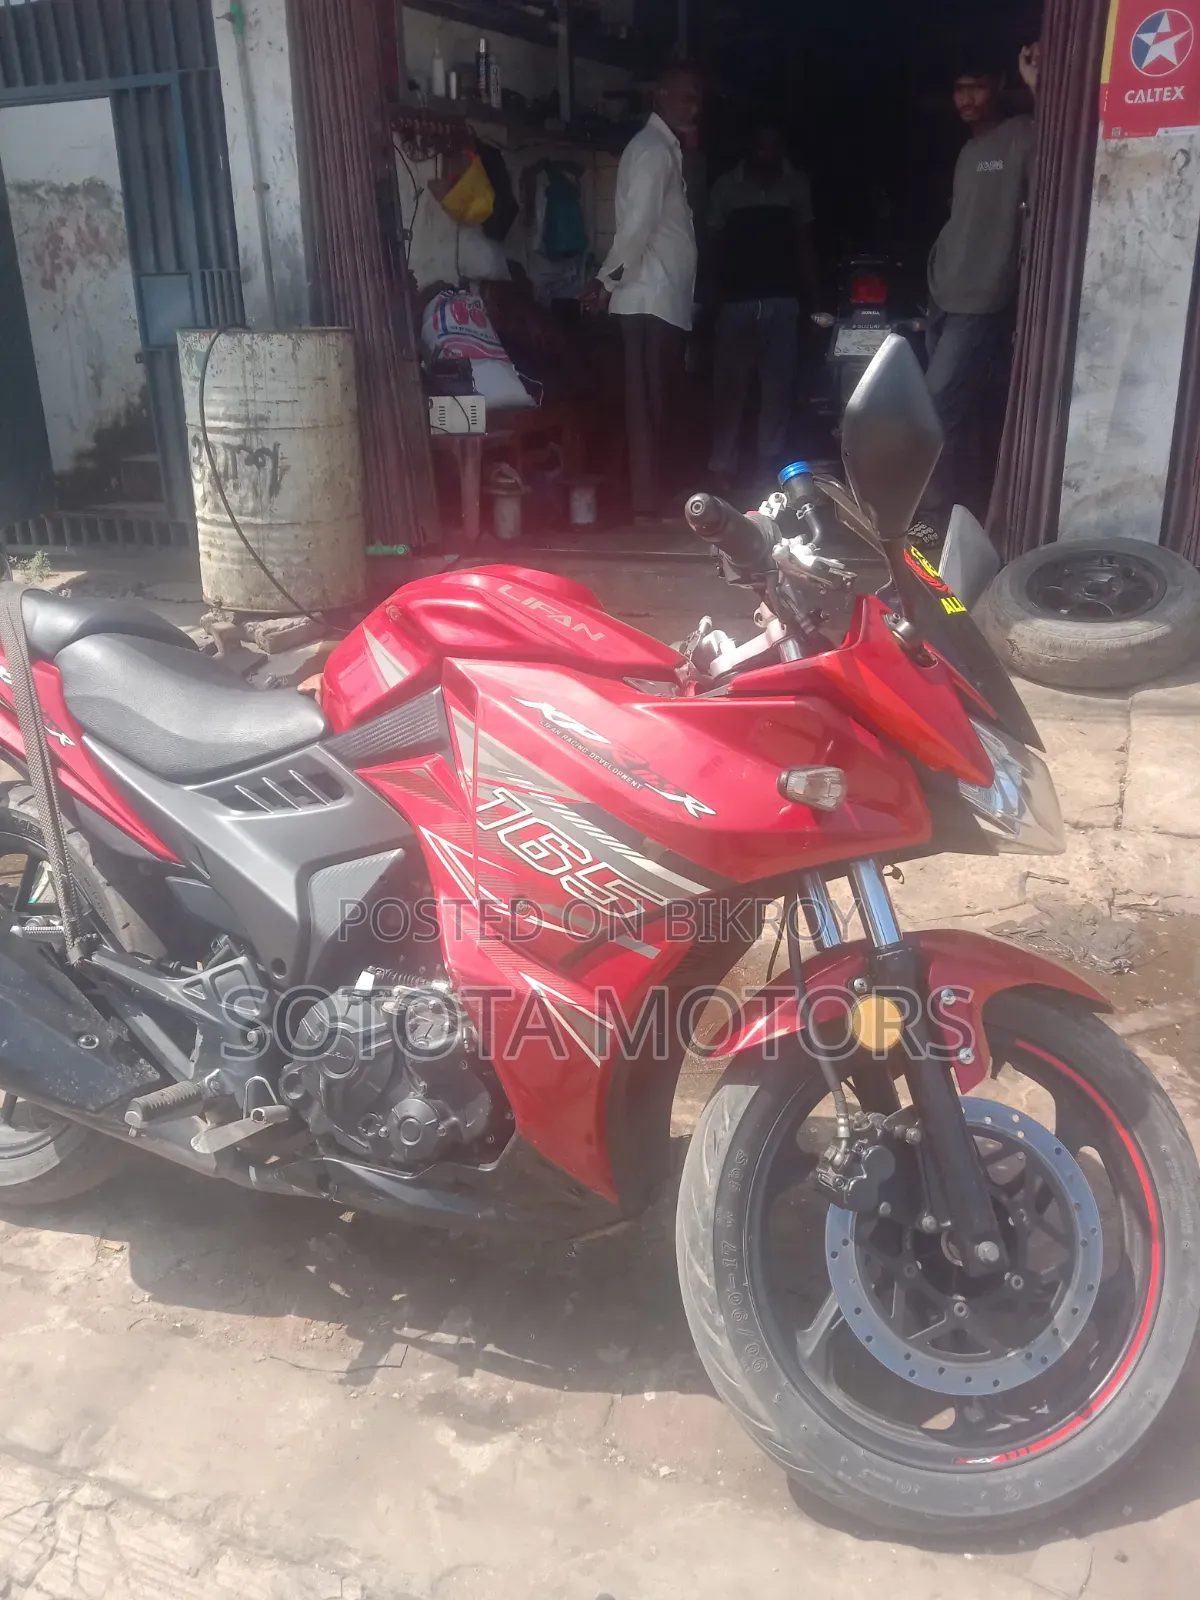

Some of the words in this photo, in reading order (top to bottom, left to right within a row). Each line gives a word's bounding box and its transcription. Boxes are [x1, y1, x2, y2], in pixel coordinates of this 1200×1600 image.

[1124, 85, 1185, 104] CALTEX
[496, 584, 606, 642] LIFAN
[539, 719, 561, 735] LIFAN
[561, 733, 589, 754] RACING
[589, 751, 644, 790] DEVELOPMENT
